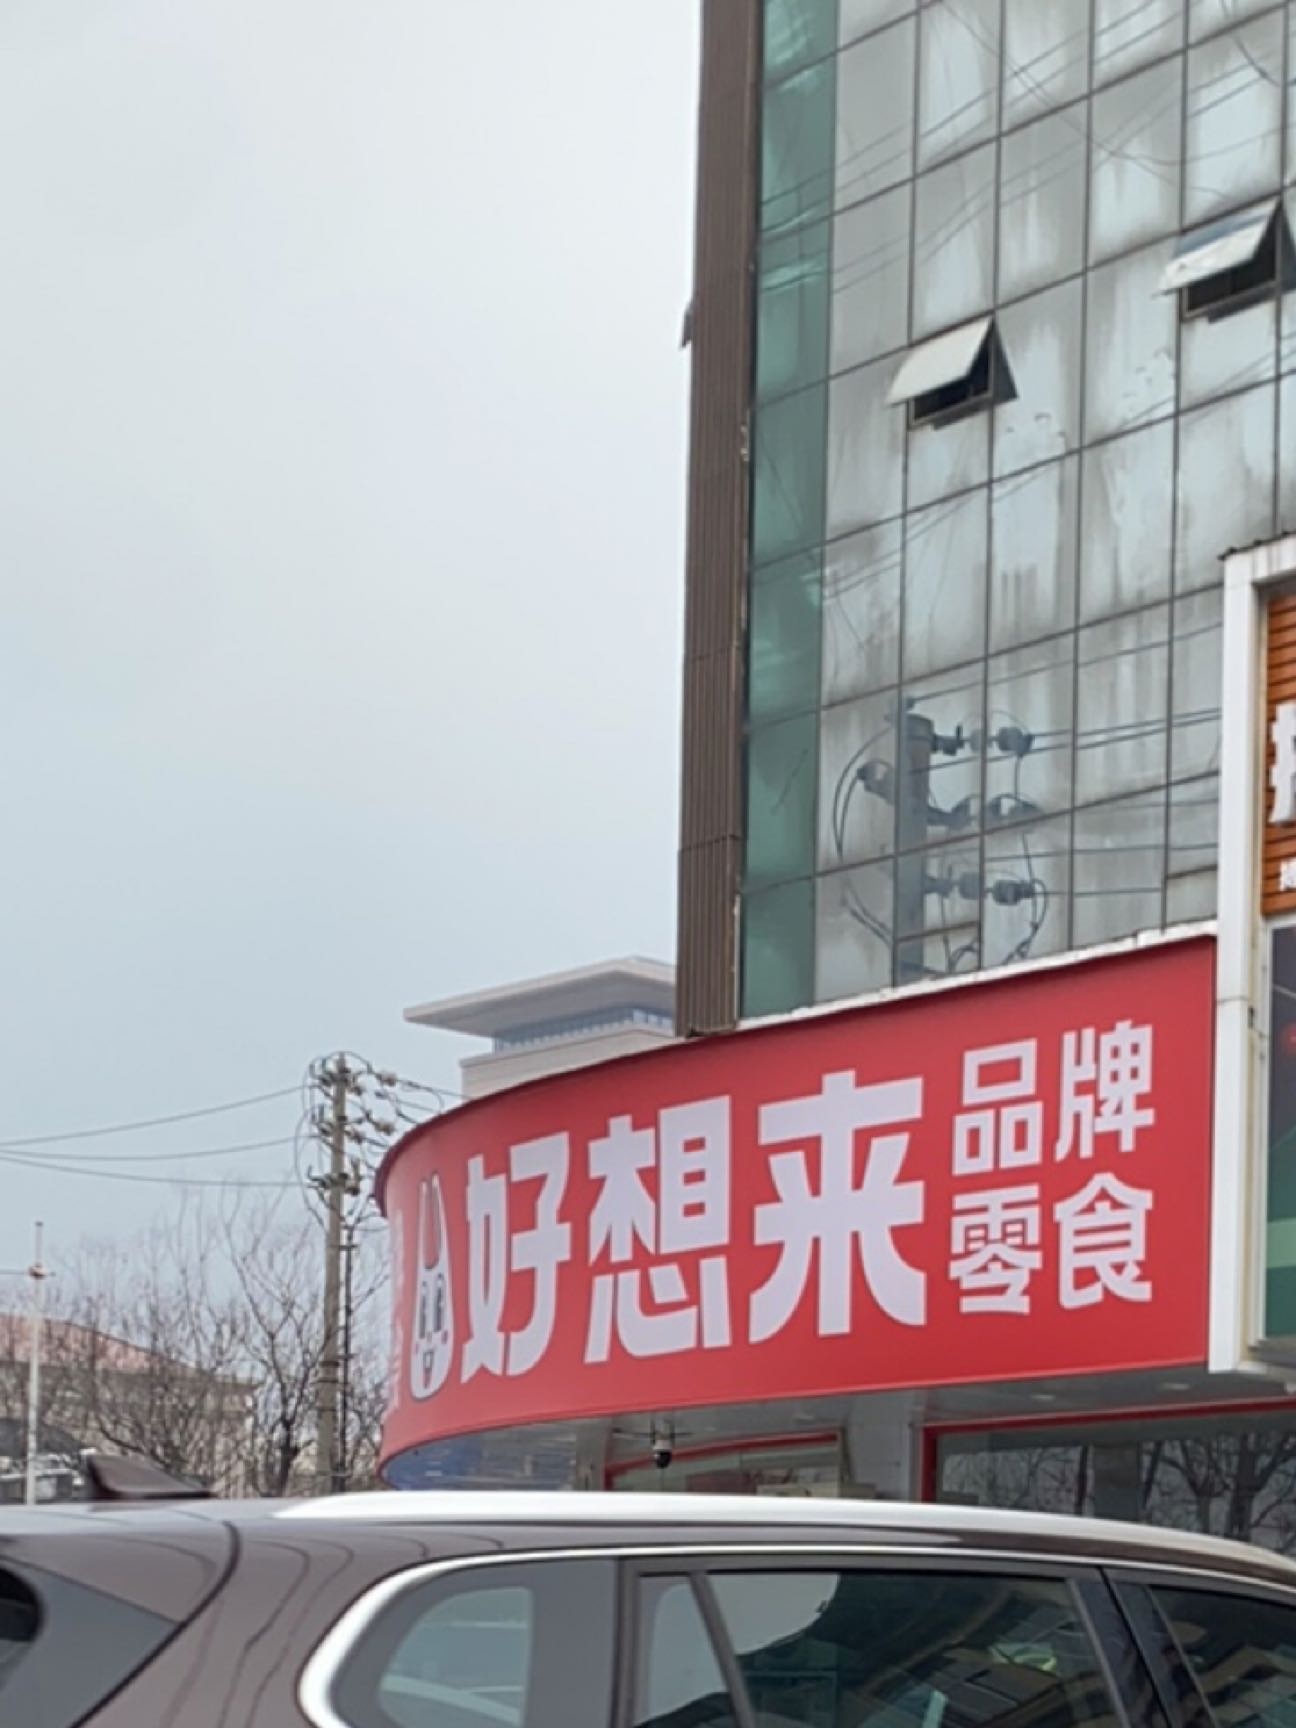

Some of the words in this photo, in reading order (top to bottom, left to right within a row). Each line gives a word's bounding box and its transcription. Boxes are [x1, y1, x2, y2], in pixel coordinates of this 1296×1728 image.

[951, 1019, 1154, 1176] 品牌
[461, 1069, 927, 1384] 好想来
[948, 1173, 1154, 1315] 零食
